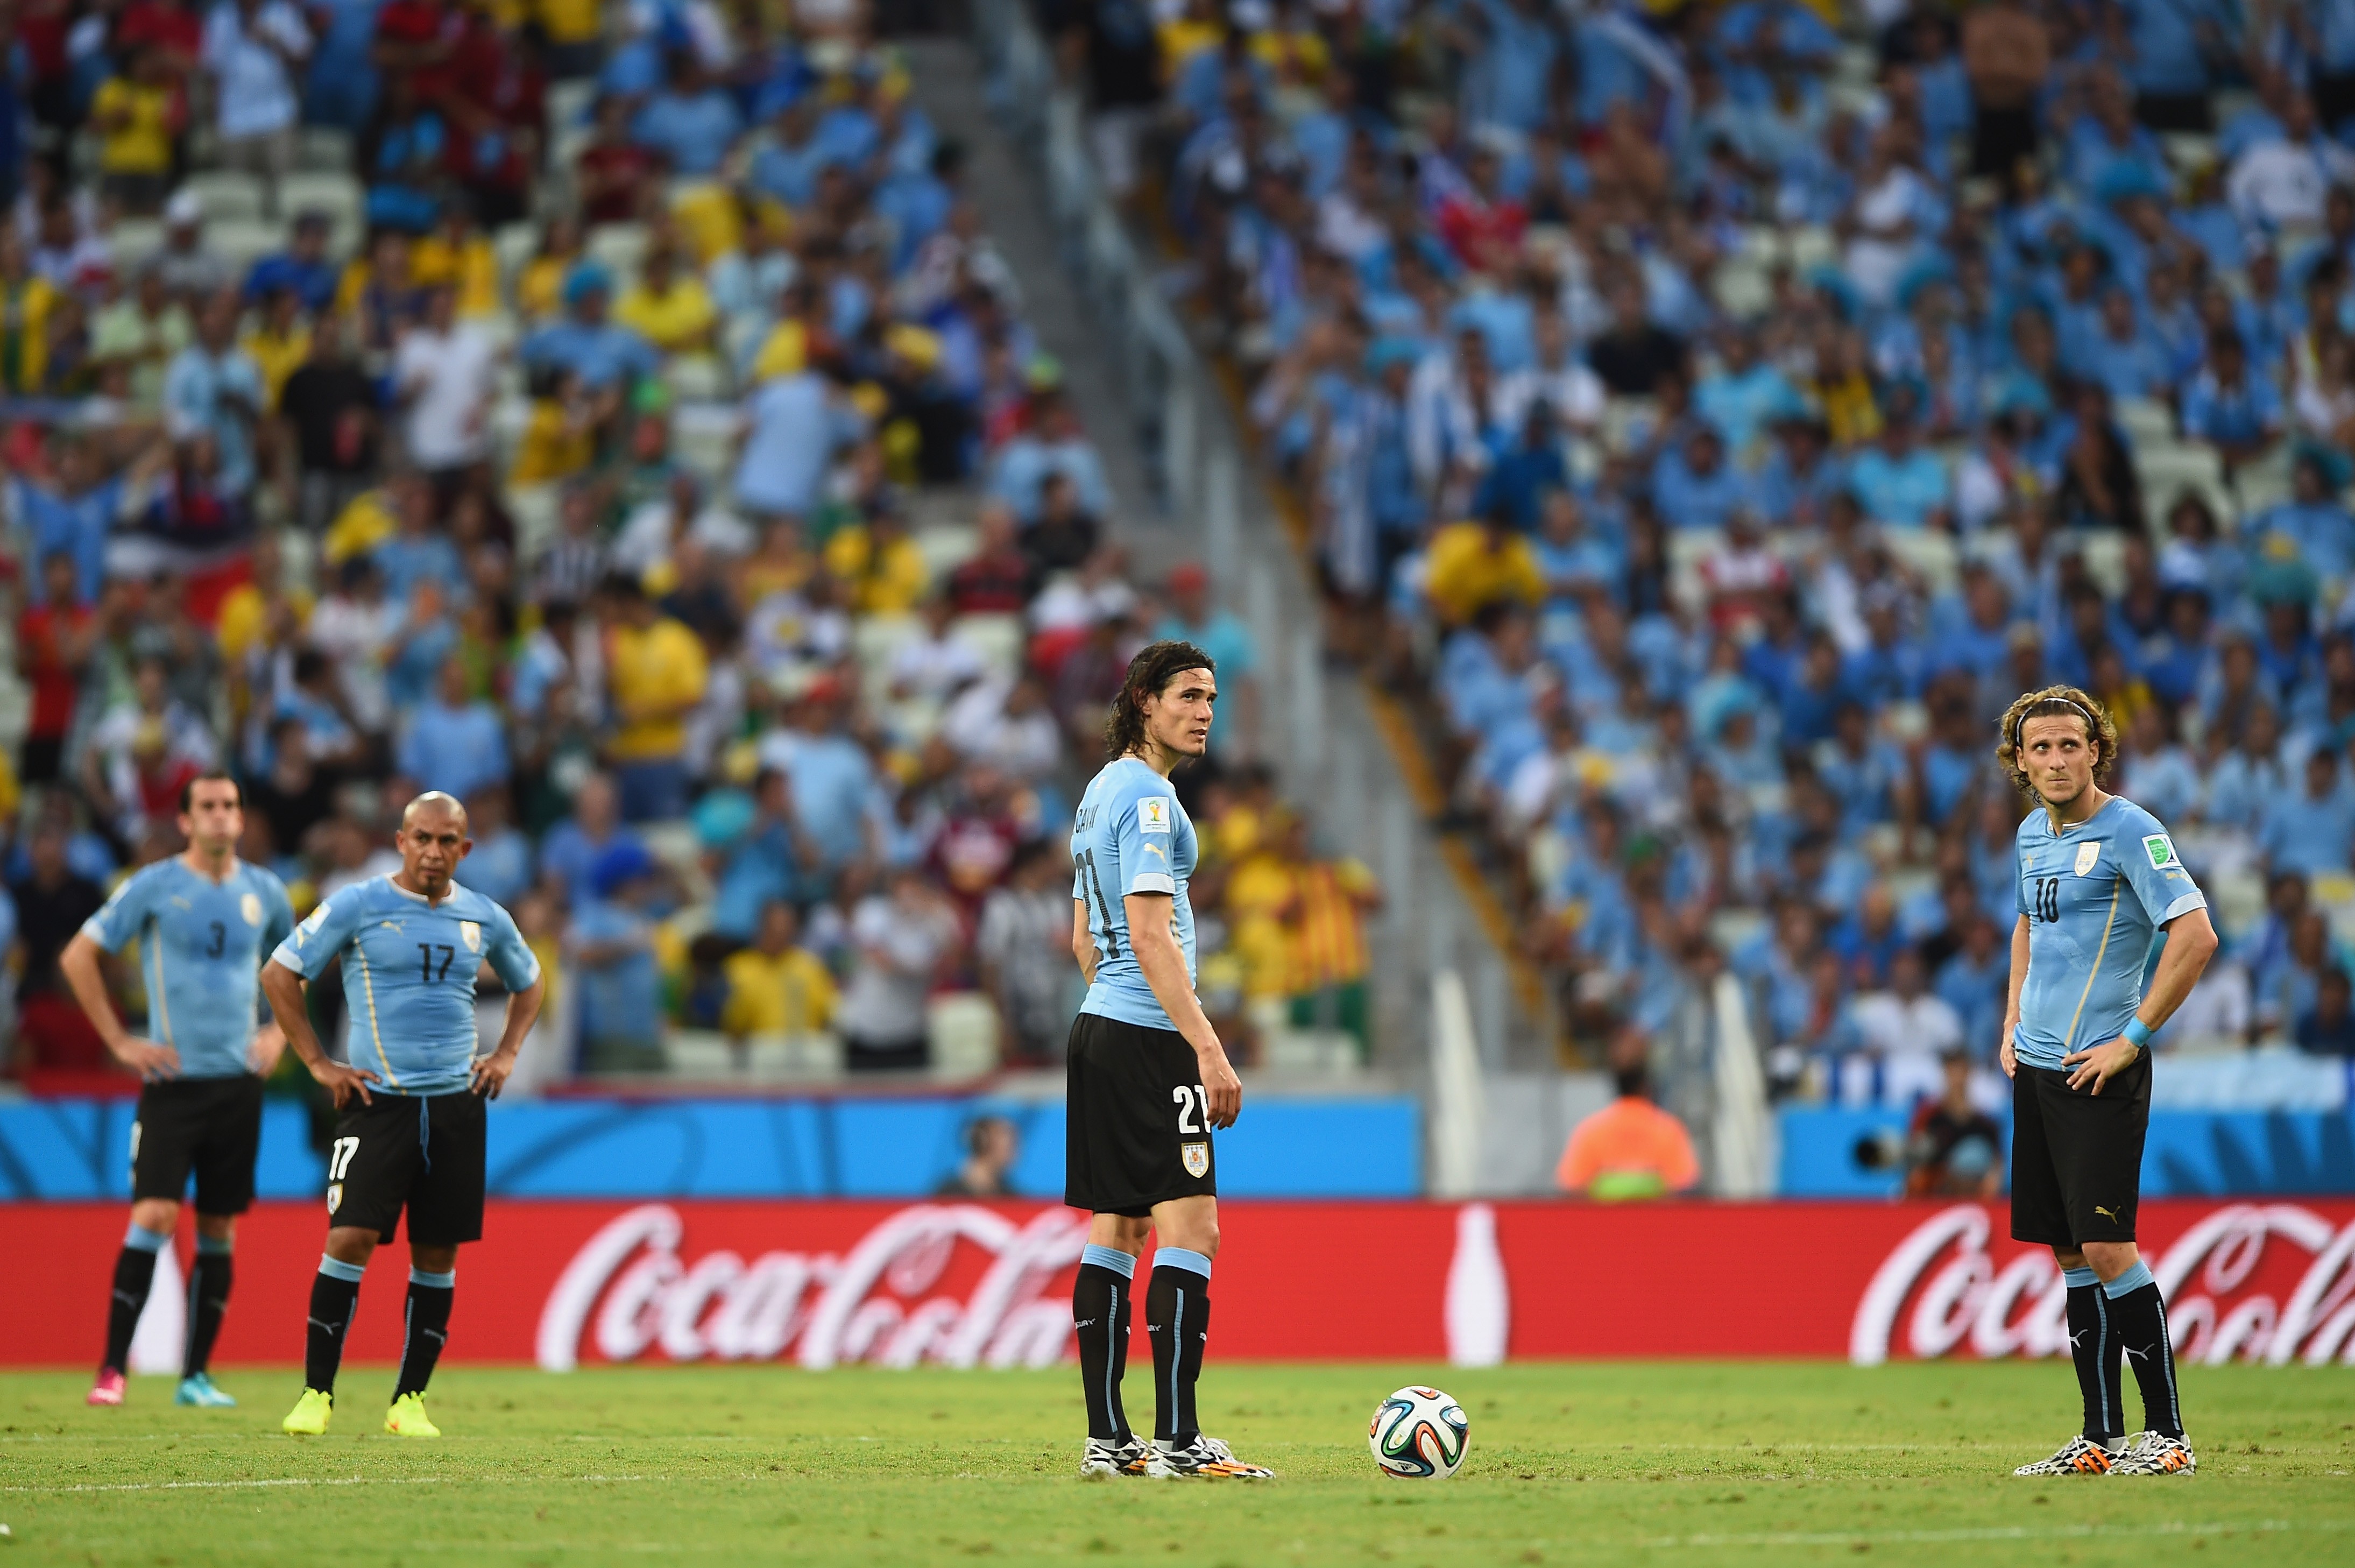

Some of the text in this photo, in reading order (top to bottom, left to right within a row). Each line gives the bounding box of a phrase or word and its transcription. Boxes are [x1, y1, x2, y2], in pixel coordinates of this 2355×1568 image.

[2035, 877, 2060, 923] 10
[206, 920, 226, 960] 3
[418, 942, 455, 981] 17
[1173, 1084, 1211, 1134] 21
[329, 1136, 360, 1181] 17
[536, 1203, 1089, 1372] Coca-Cola
